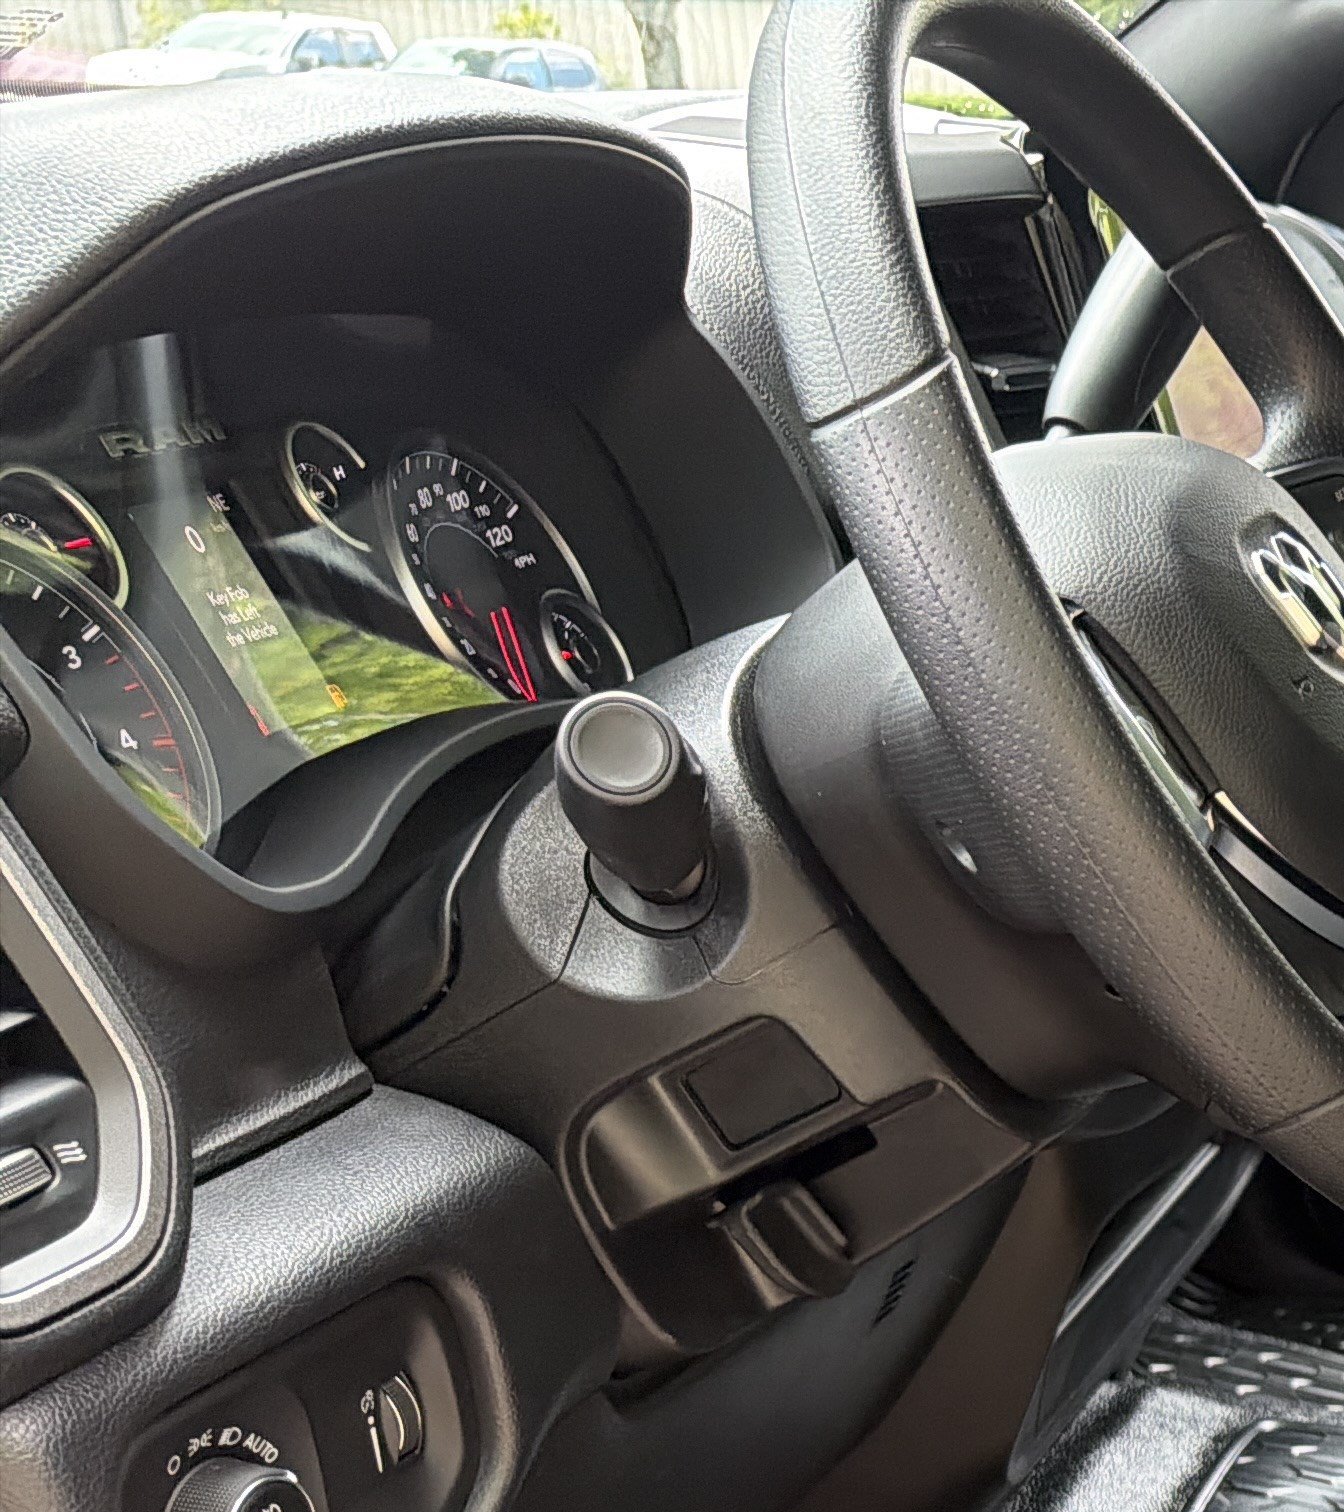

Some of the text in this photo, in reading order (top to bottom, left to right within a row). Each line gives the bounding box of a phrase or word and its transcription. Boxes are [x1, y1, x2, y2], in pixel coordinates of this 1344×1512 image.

[332, 464, 347, 482] H
[206, 493, 231, 513] NE
[416, 486, 434, 509] 80
[446, 489, 470, 513] 100
[473, 503, 491, 520] 110
[184, 525, 206, 554] 0
[485, 524, 514, 548] 120
[206, 584, 250, 608] Key Fob
[219, 603, 262, 627] has Left
[225, 621, 279, 649] the Vehicle
[62, 645, 82, 669] 3
[120, 728, 139, 750] 4
[242, 1432, 279, 1465] AUTO
